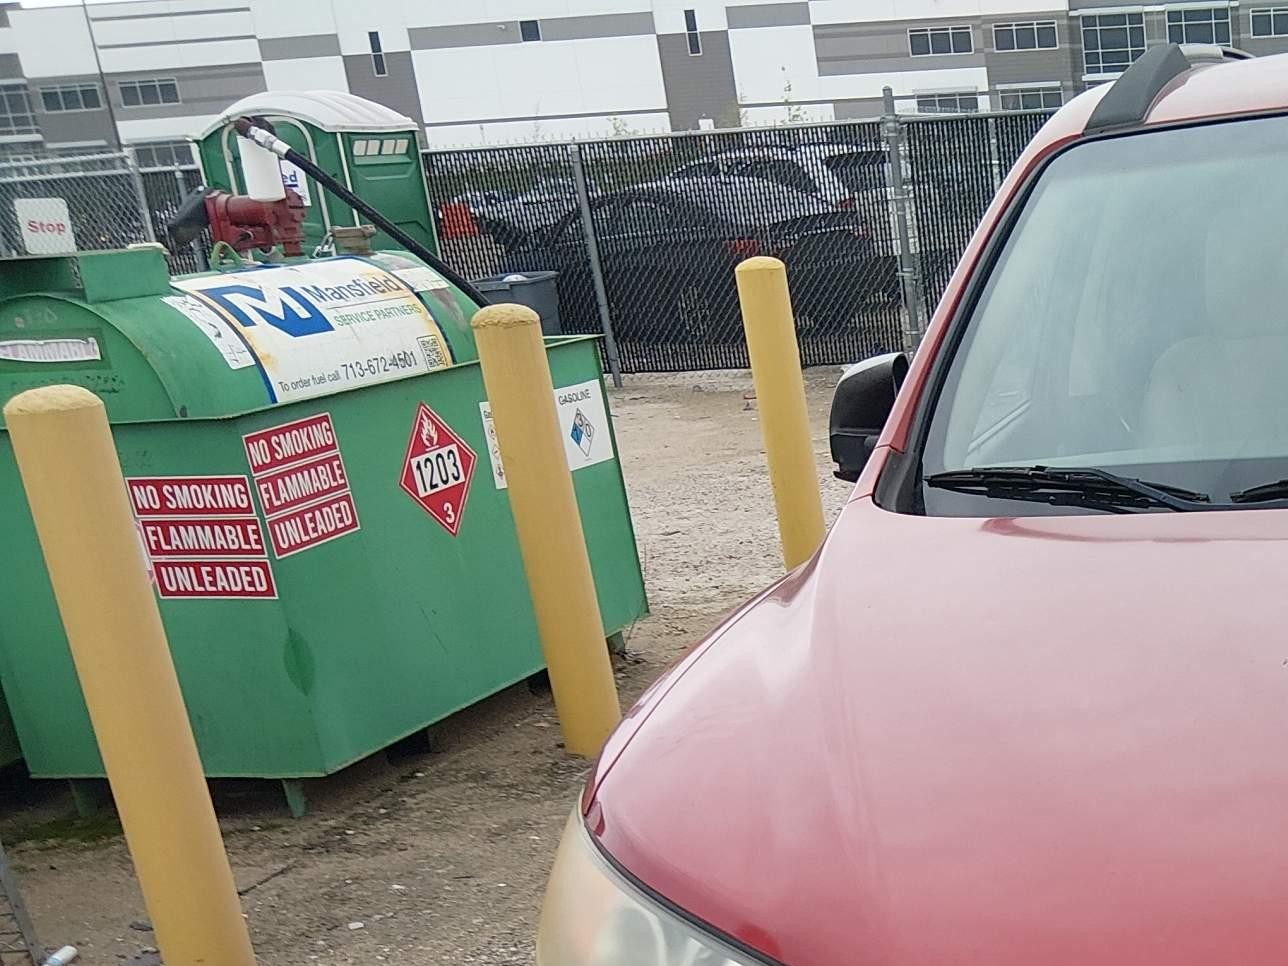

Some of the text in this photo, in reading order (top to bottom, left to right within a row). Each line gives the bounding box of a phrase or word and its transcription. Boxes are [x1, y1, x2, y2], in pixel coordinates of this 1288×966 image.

[27, 220, 66, 236] Stop
[303, 274, 401, 303] Mansfield
[333, 302, 423, 327] SERVICE PARTNERS
[278, 350, 419, 392] To order fuel call 713-672-4501
[558, 388, 592, 406] GASOLINE
[248, 421, 334, 468] NO SMOKING
[259, 460, 345, 510] FLAMMABLE
[416, 449, 461, 493] 1203
[132, 483, 249, 510] NO SMOKING
[274, 500, 353, 549] UNLEADED
[443, 501, 456, 524] 3
[145, 523, 263, 551] FLAMMABLE
[160, 566, 268, 592] UNLEADED
